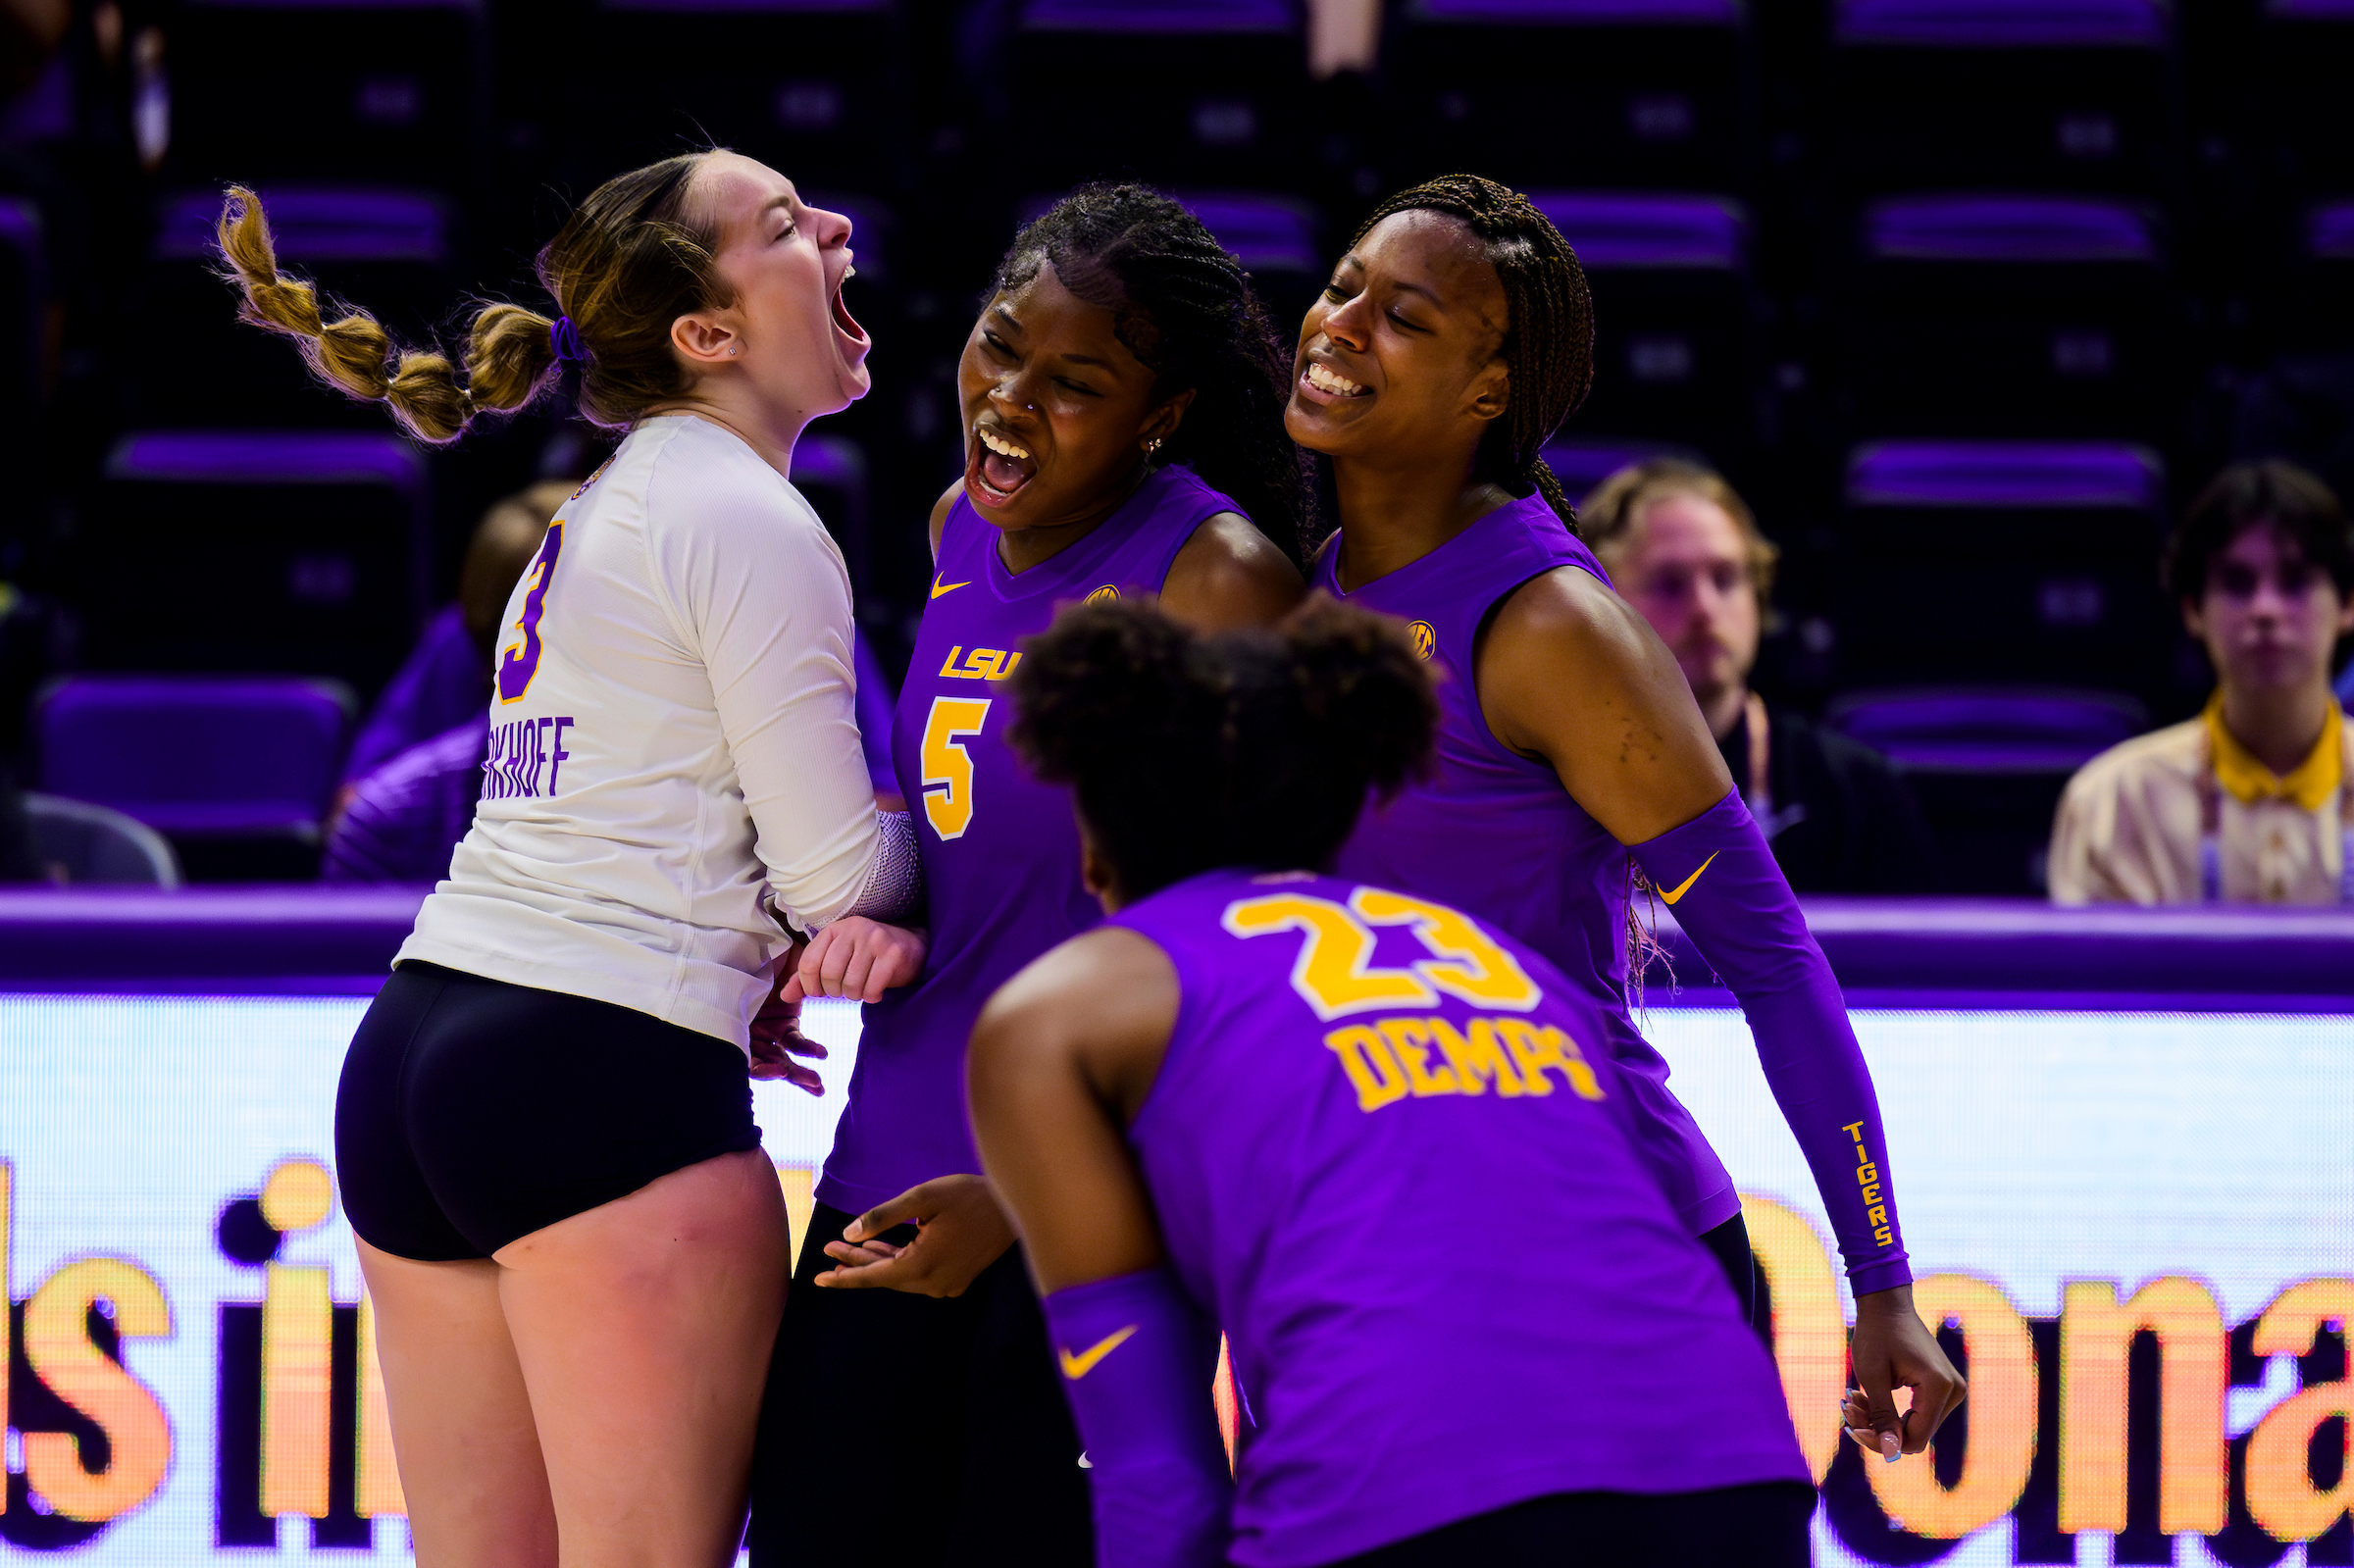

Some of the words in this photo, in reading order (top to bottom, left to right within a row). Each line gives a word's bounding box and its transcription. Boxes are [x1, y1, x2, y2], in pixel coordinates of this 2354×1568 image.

[498, 520, 566, 705] 3
[939, 645, 1023, 681] LSU
[920, 695, 993, 841] 5
[1221, 885, 1543, 1022] 23
[1842, 1121, 1893, 1247] TIGERS
